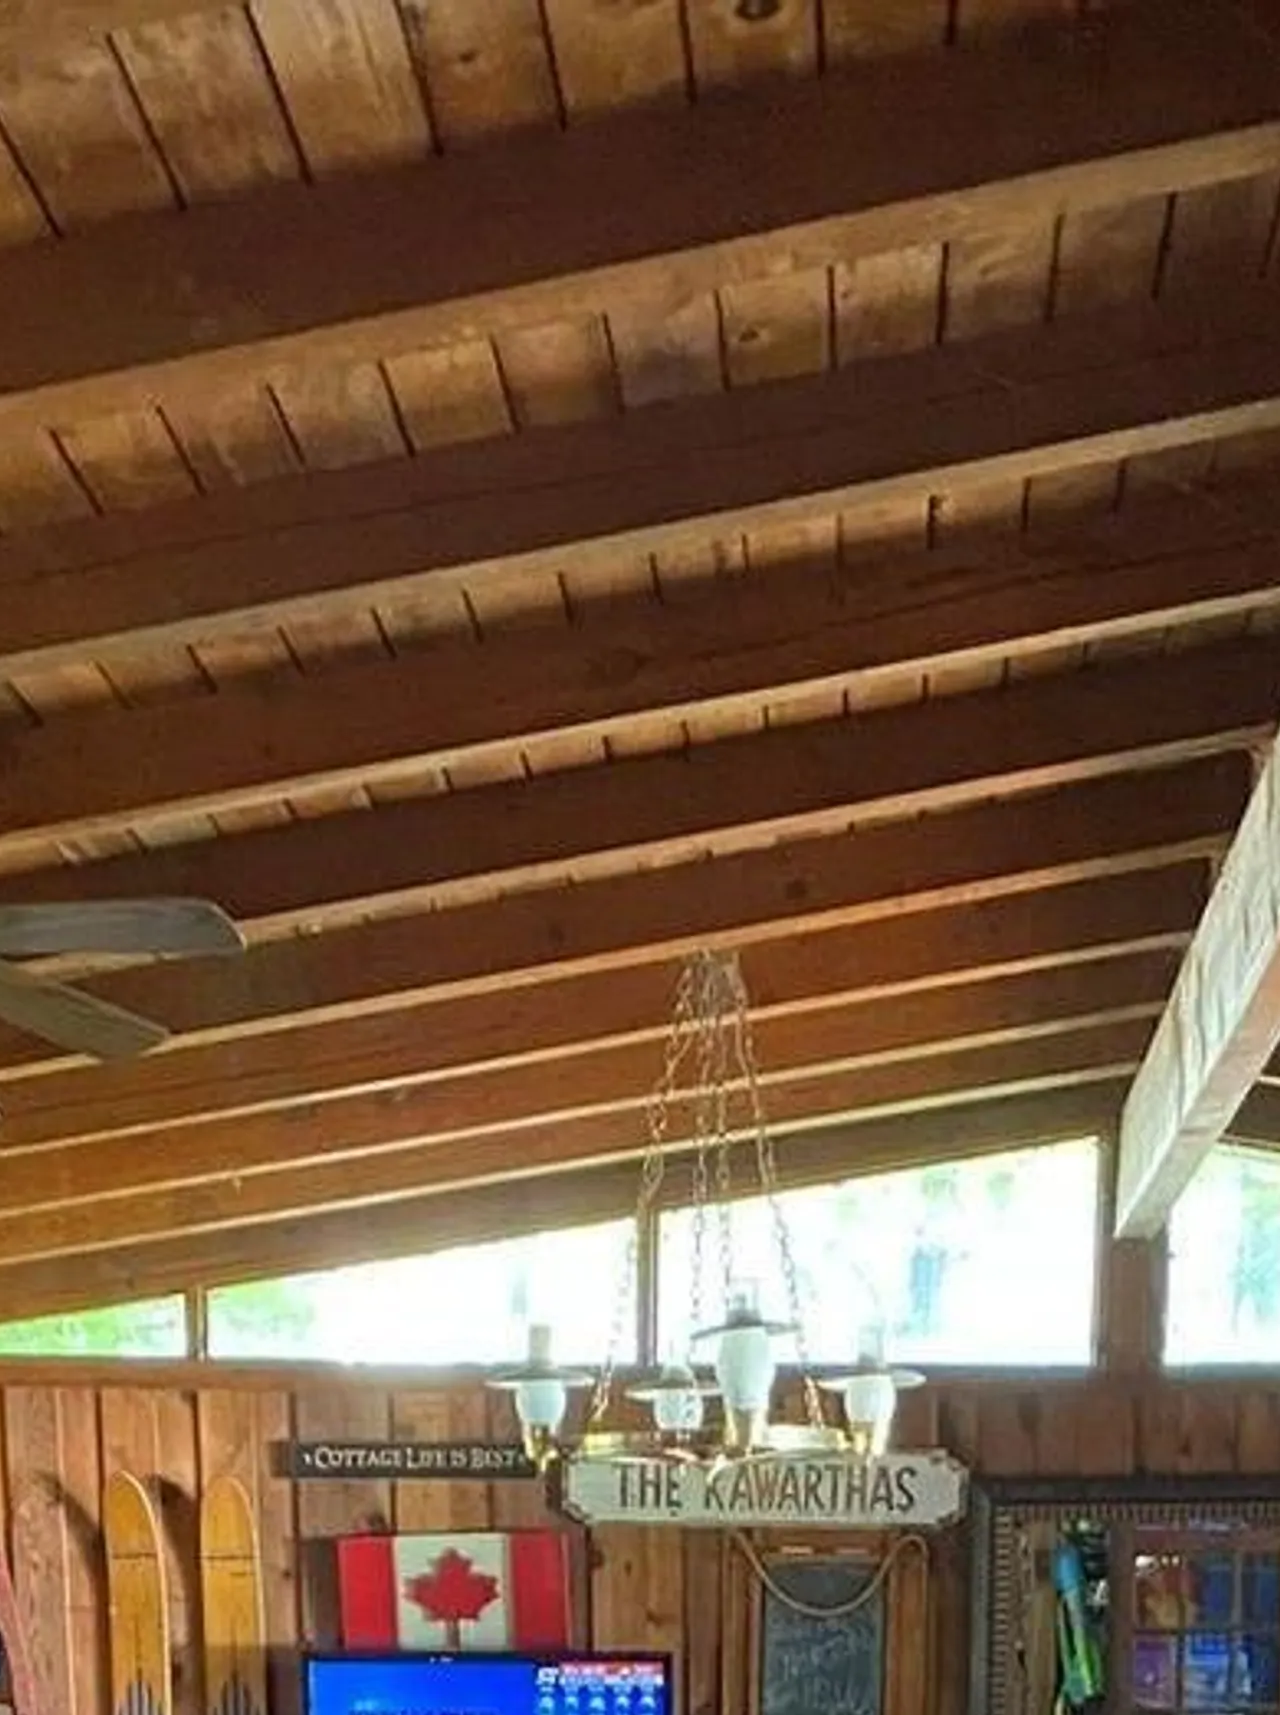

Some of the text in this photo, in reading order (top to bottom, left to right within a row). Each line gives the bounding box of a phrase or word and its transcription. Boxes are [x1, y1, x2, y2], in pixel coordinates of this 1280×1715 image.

[314, 1446, 402, 1468] COTTAGE
[613, 1462, 918, 1514] THE KAWARTHAS
